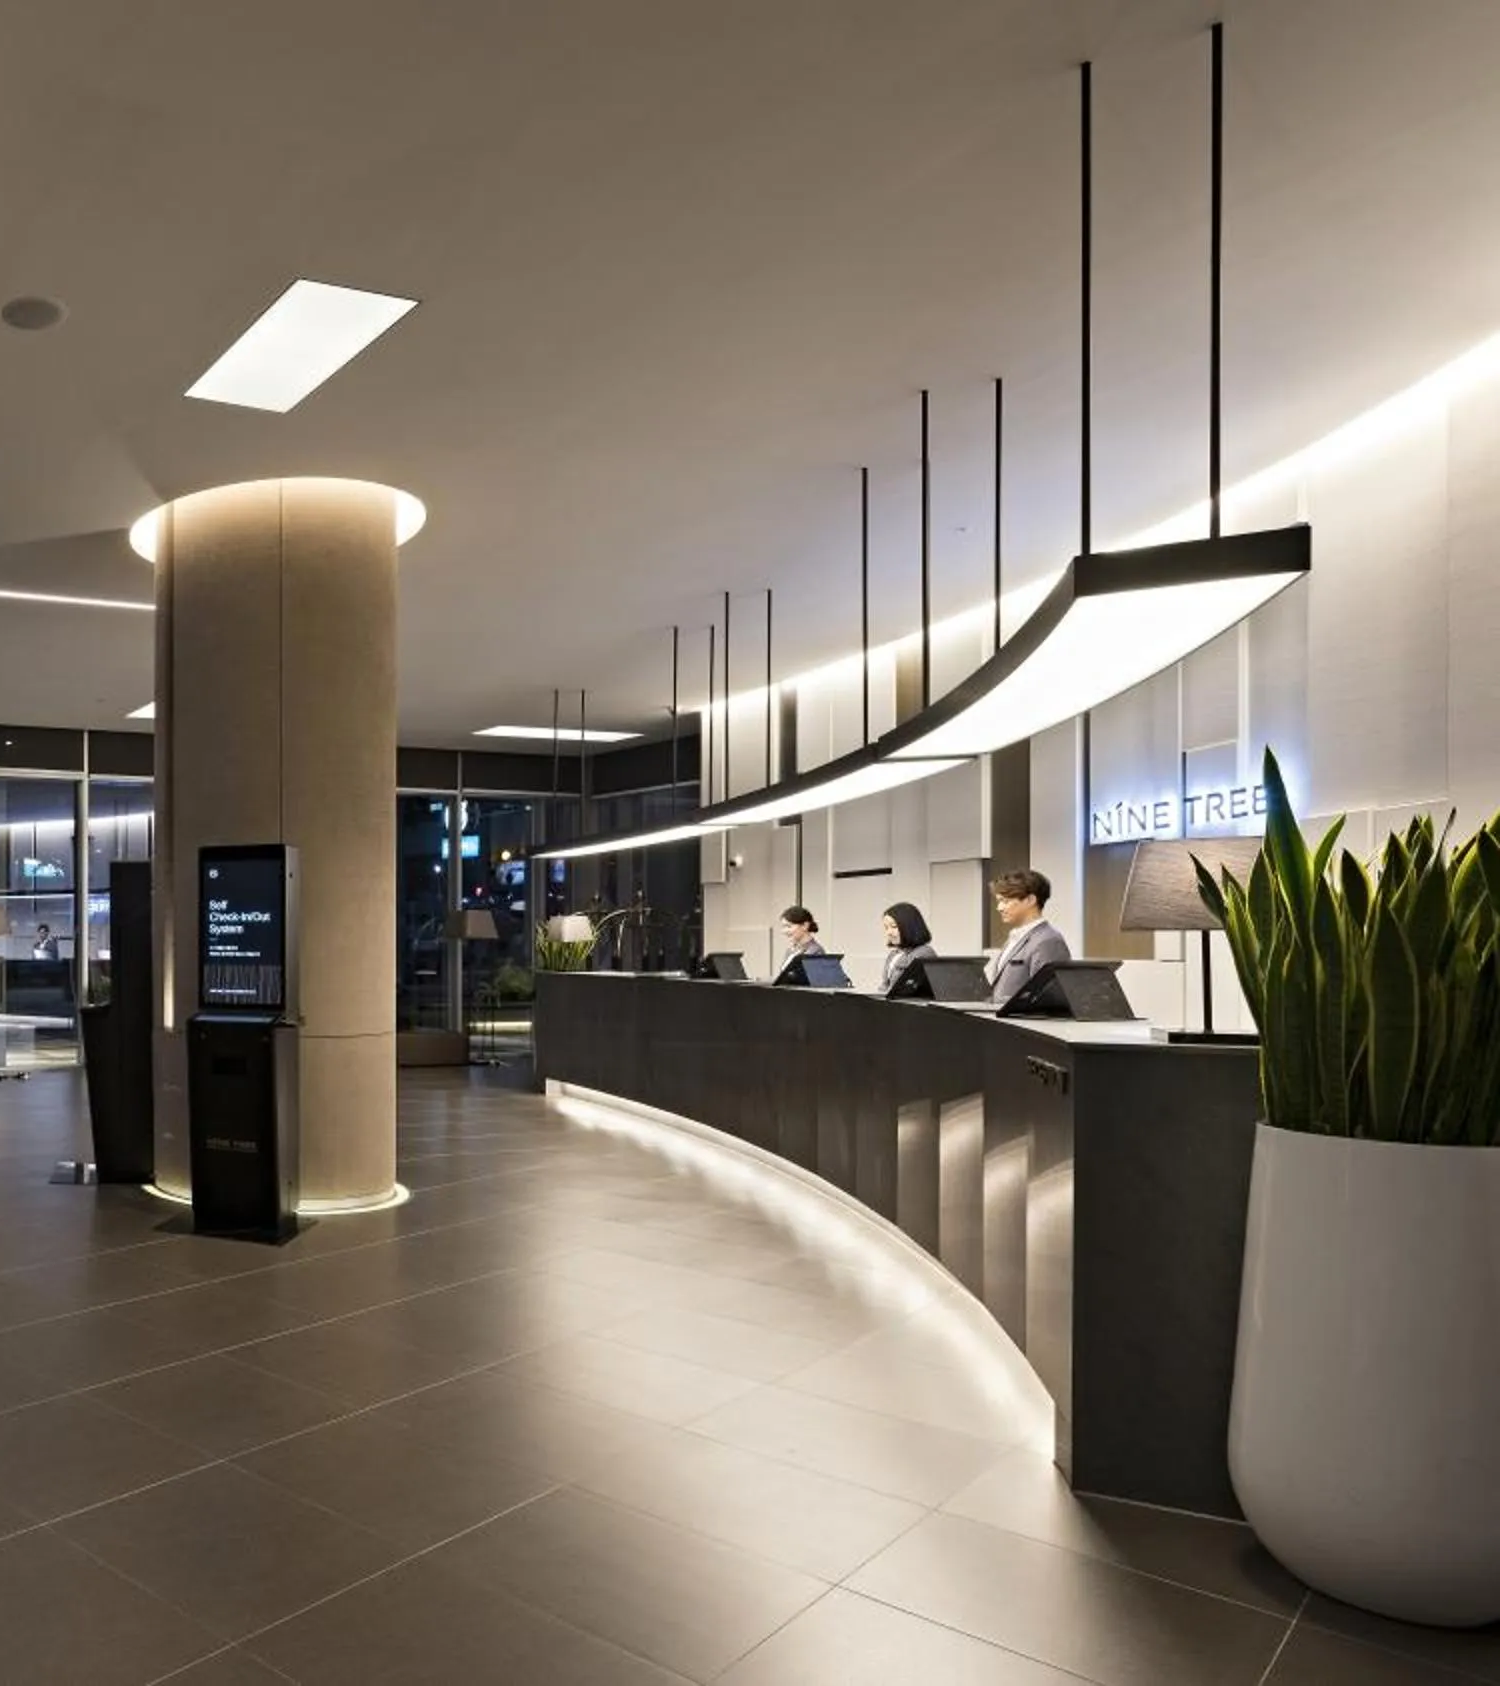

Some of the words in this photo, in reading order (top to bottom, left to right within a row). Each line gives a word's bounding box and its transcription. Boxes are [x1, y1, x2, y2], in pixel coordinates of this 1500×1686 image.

[1184, 784, 1269, 825] TREE
[209, 899, 228, 910] Self
[209, 923, 244, 935] System
